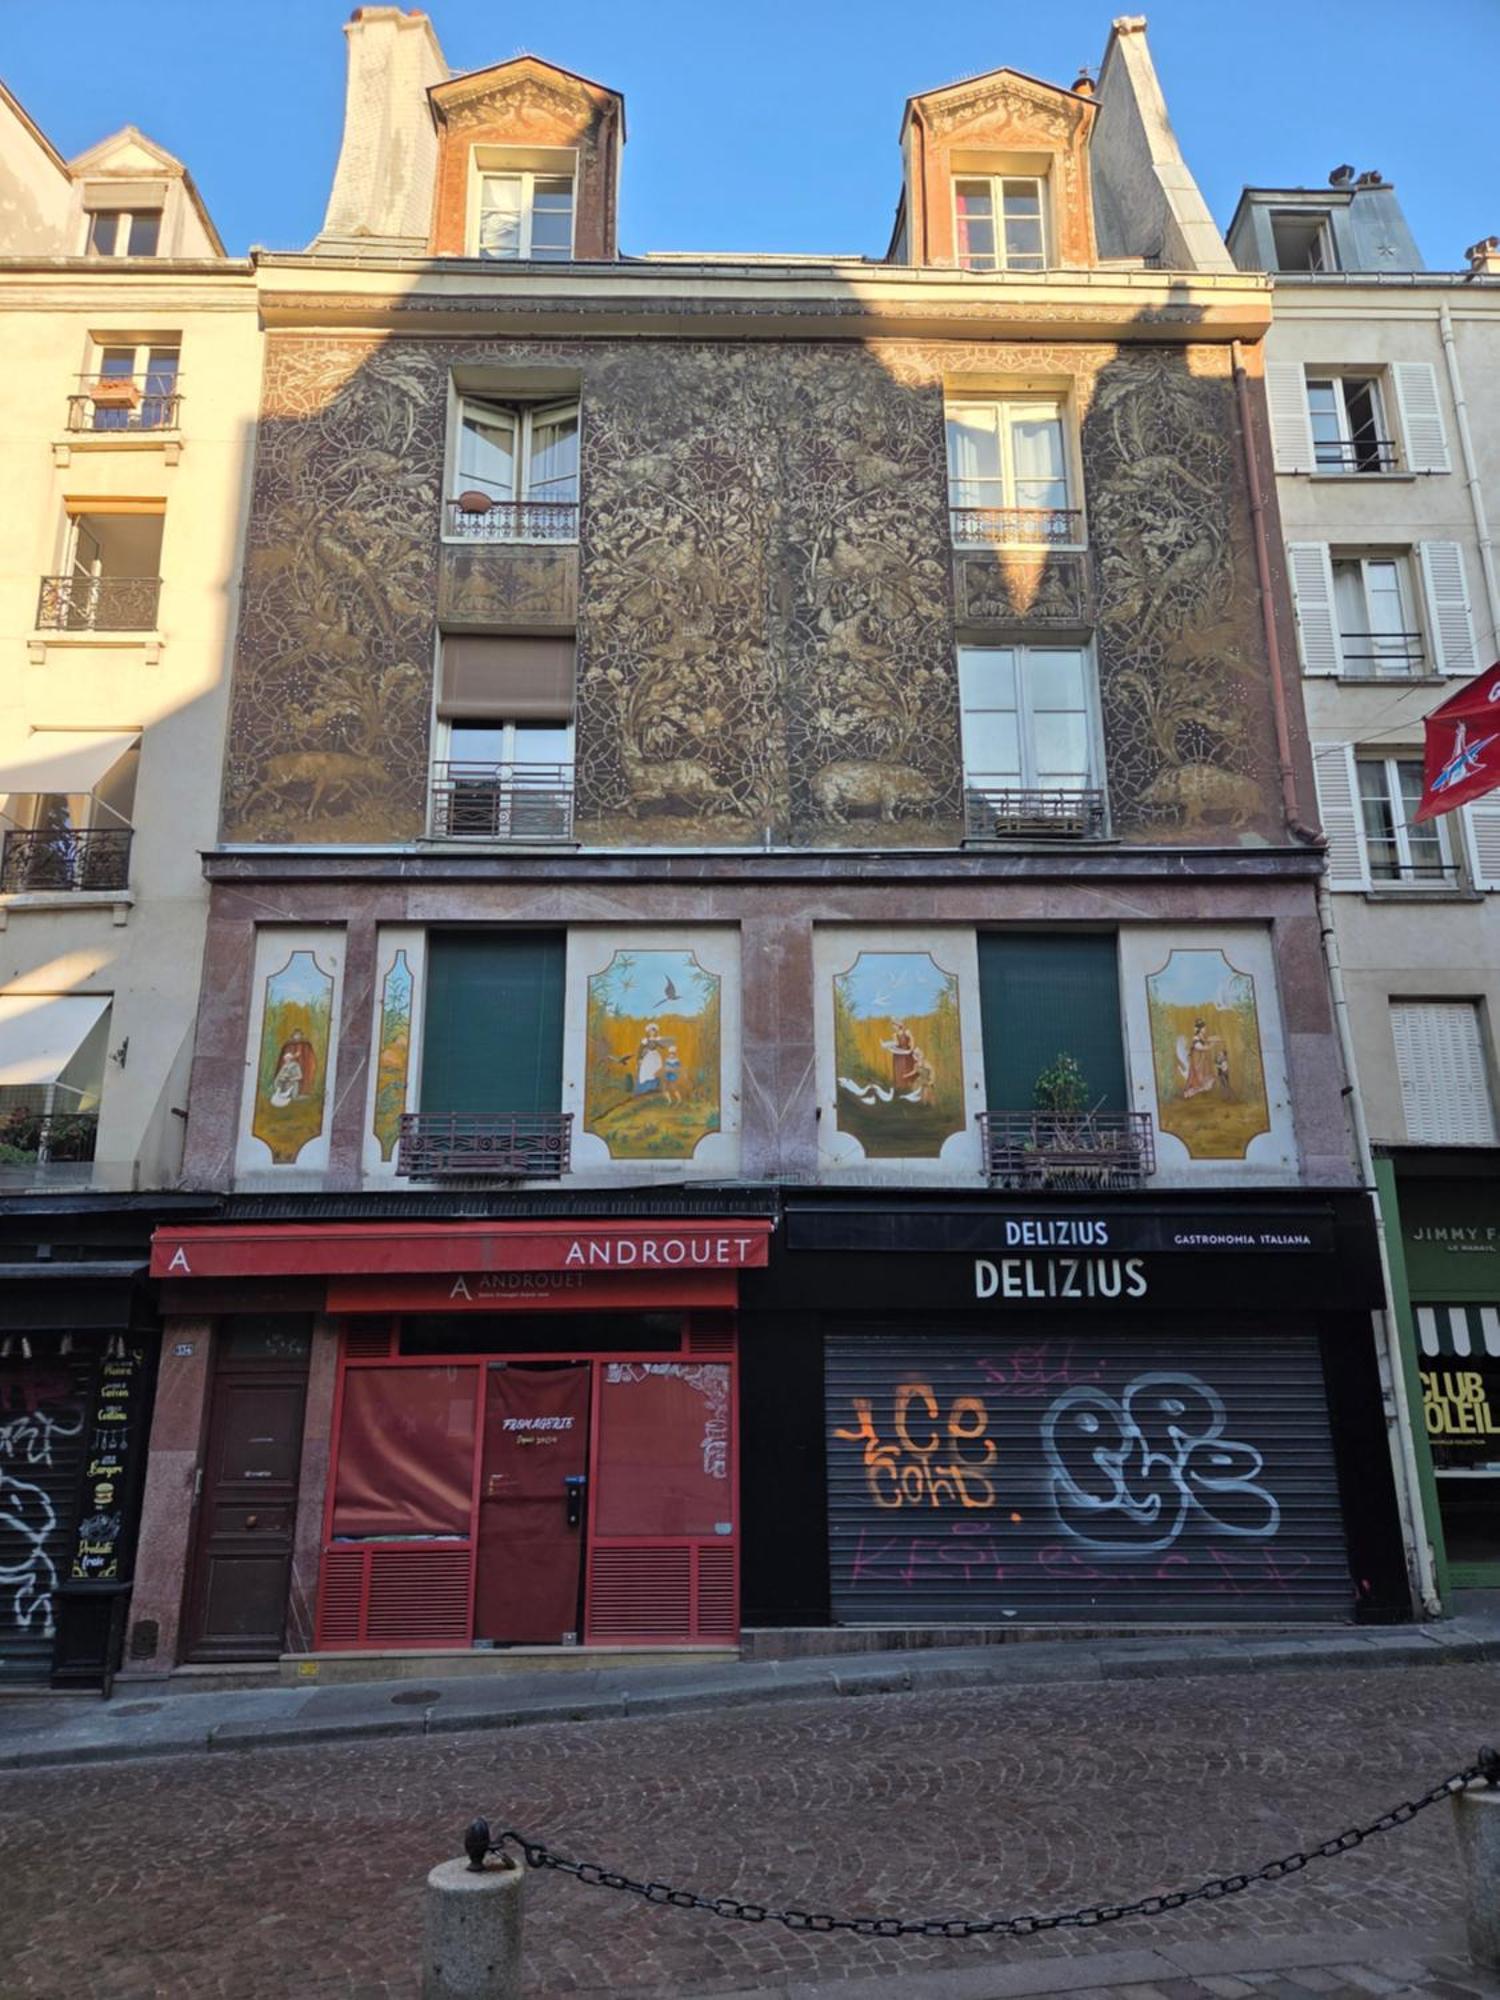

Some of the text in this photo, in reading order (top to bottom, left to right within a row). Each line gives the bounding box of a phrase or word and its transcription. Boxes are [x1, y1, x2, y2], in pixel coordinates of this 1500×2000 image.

[1005, 1221, 1109, 1245] DELIZIUS
[1174, 1234, 1311, 1245] GASTRONOMIA ITALIANA
[1413, 1227, 1477, 1240] JIMMY
[168, 1247, 191, 1272] A
[565, 1238, 752, 1265] ANDROUET
[450, 1274, 473, 1300] A
[480, 1272, 585, 1289] ANDROUET
[974, 1258, 1148, 1298] DELIZIUS
[1419, 1371, 1486, 1404] CLUB
